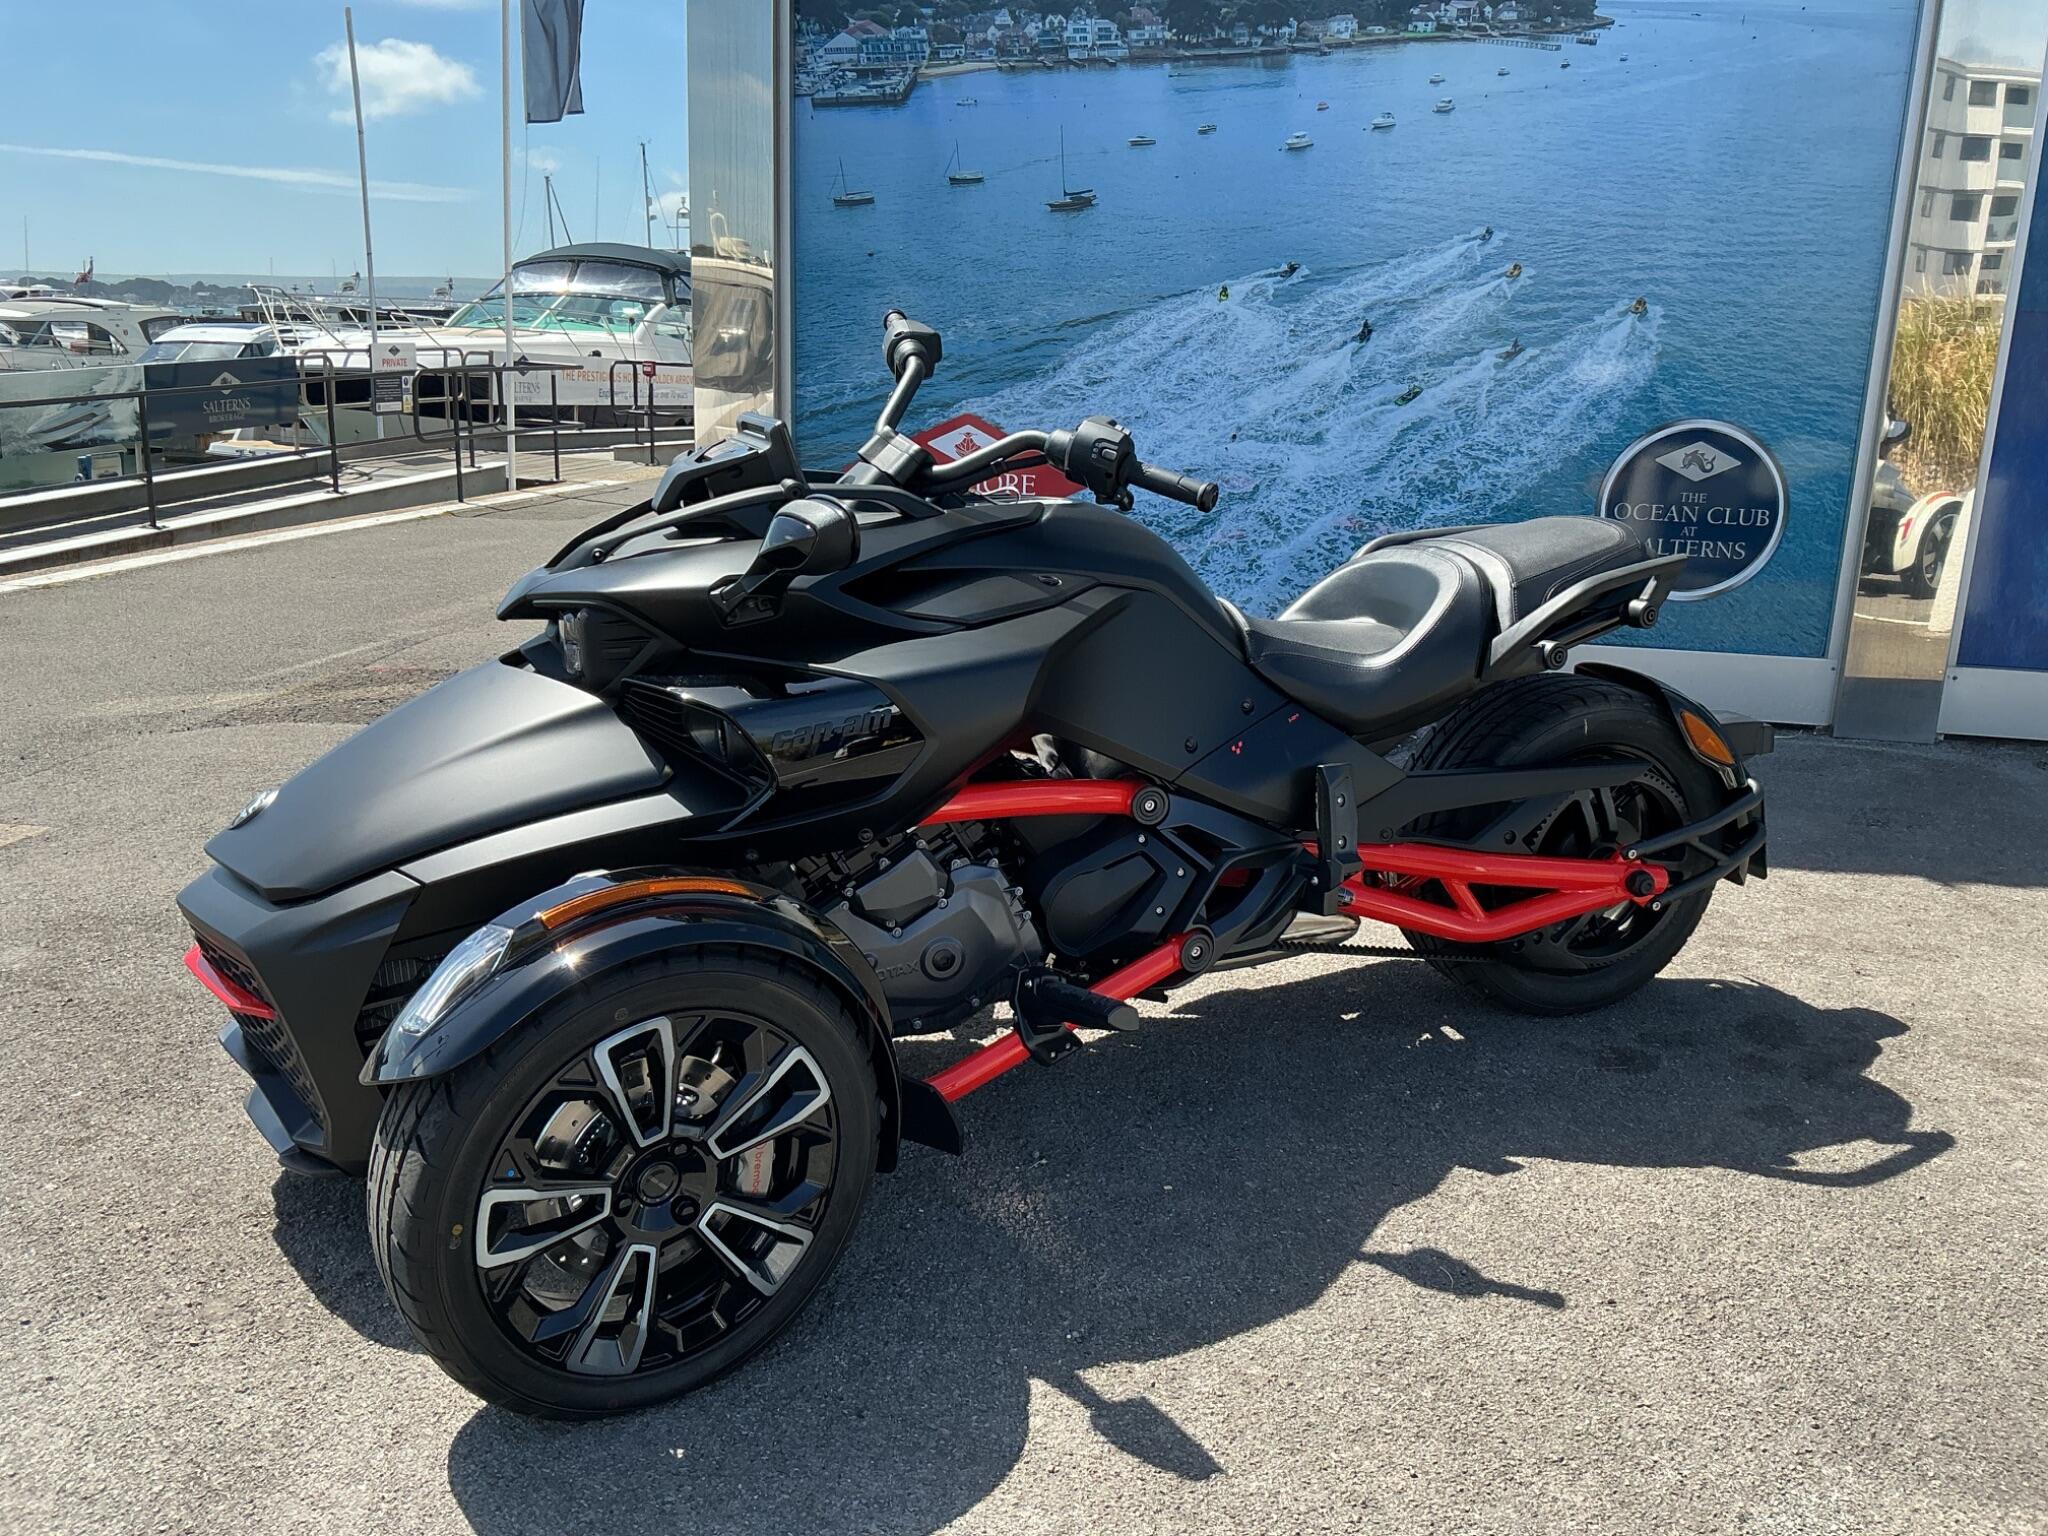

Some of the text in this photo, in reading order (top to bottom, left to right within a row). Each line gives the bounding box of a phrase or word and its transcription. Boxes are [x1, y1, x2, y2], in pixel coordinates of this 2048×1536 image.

[382, 358, 408, 368] PRIVATE
[622, 371, 641, 384] HOE
[514, 381, 541, 394] LTERNS
[202, 397, 251, 414] SALTERNS
[1680, 492, 1708, 504] THE
[1613, 502, 1770, 526] OCEAN CLUB
[1680, 526, 1698, 537] AT
[1645, 538, 1747, 560] ALTERNS
[771, 708, 893, 752] can-am
[875, 960, 919, 981] OTAX
